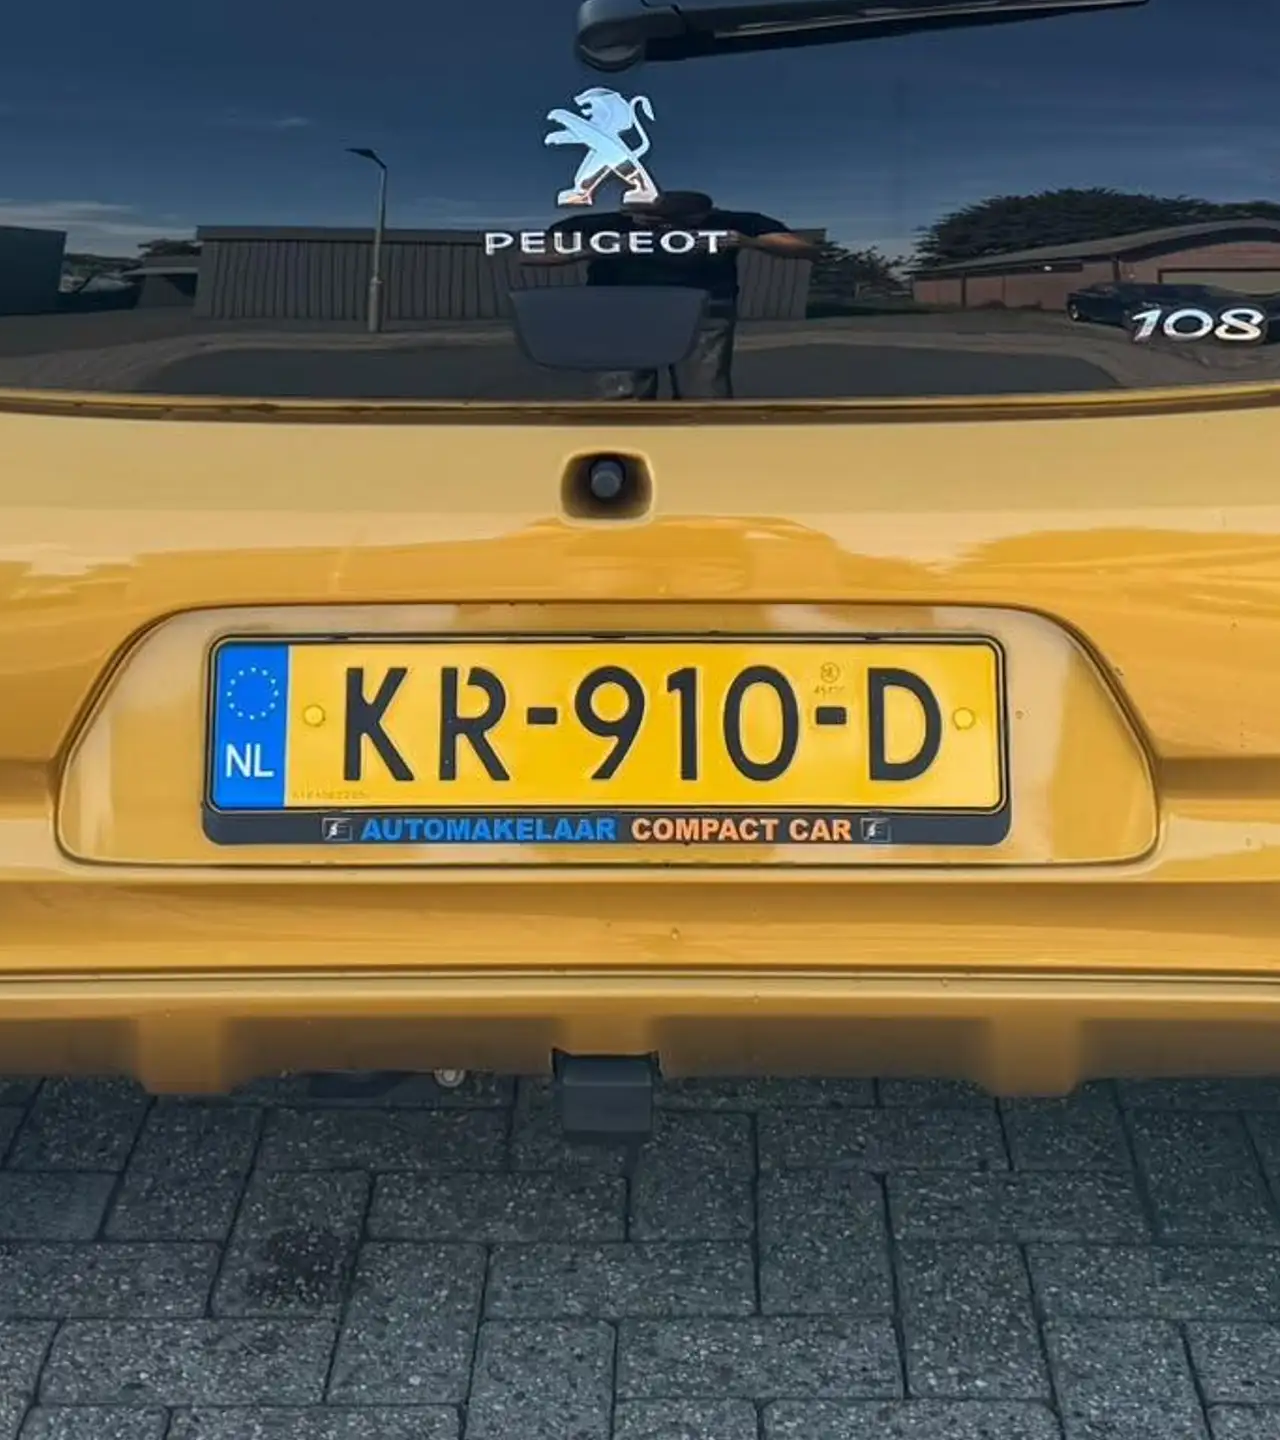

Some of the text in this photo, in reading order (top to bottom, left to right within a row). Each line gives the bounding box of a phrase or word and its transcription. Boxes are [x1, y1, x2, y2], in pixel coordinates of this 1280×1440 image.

[485, 230, 728, 255] PEUGEOT
[1132, 308, 1264, 342] 108
[344, 666, 942, 781] KR-910-D
[226, 743, 274, 778] NL
[360, 818, 852, 841] AUTOMAKELAAR COMPACT CAR
